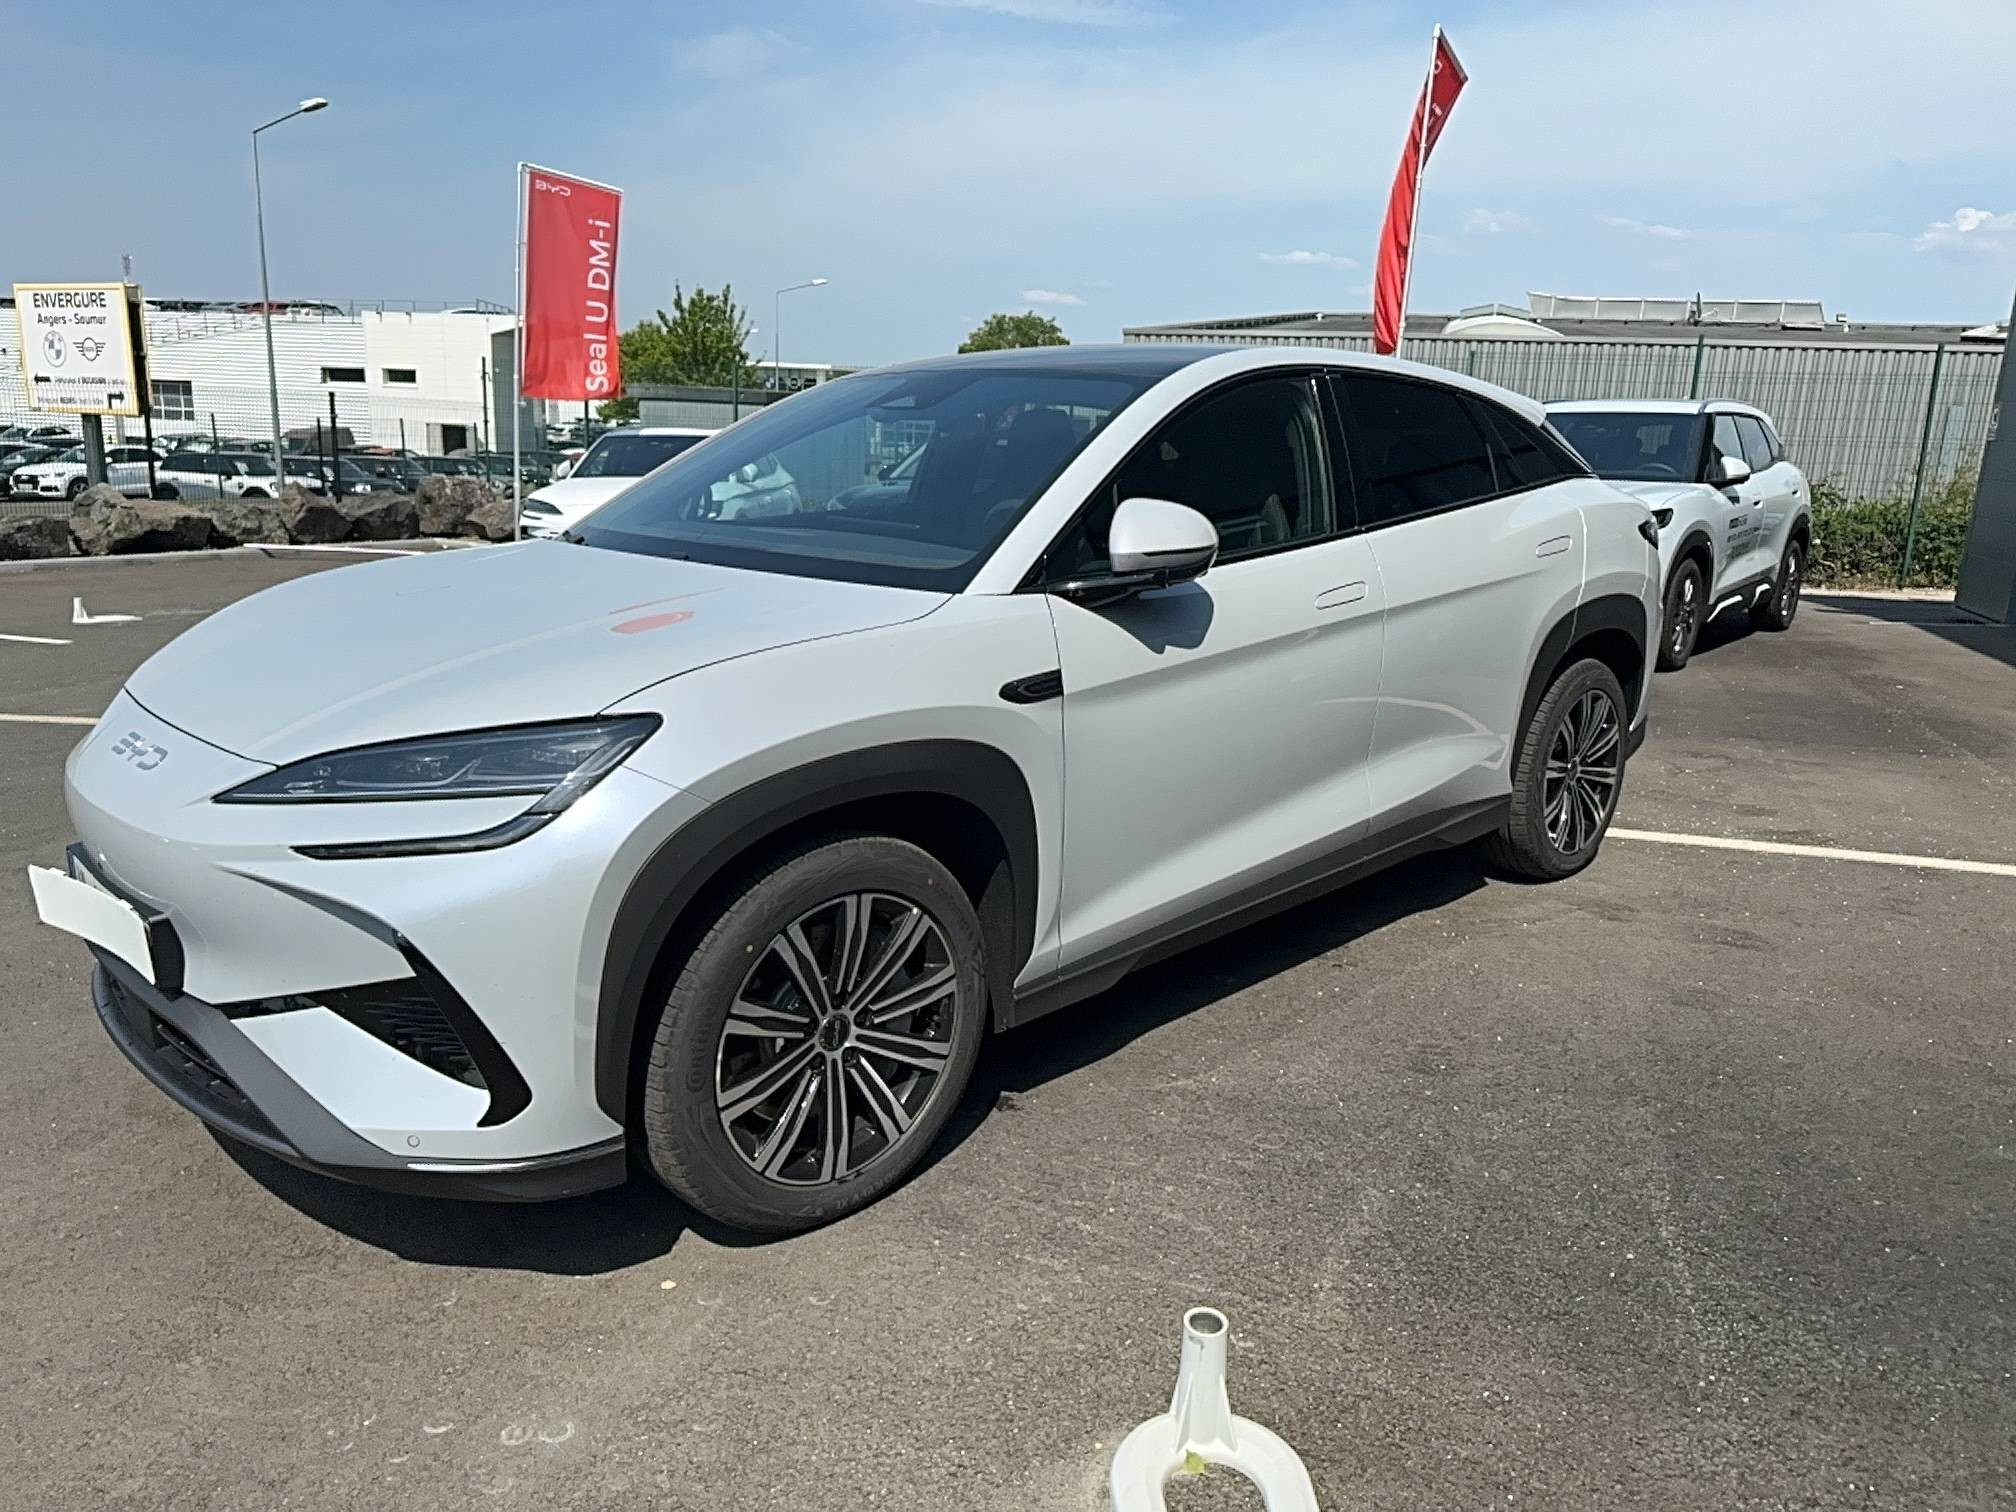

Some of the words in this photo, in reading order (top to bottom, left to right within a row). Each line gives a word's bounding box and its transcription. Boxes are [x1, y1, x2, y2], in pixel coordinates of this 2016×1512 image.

[535, 179, 571, 197] BYD
[587, 218, 611, 292] DM-i
[33, 292, 107, 308] ENVERGURE
[585, 300, 609, 323] U
[37, 313, 66, 327] Angers
[74, 313, 107, 325] Saumur
[583, 332, 608, 394] Seal
[111, 731, 169, 770] BYD
